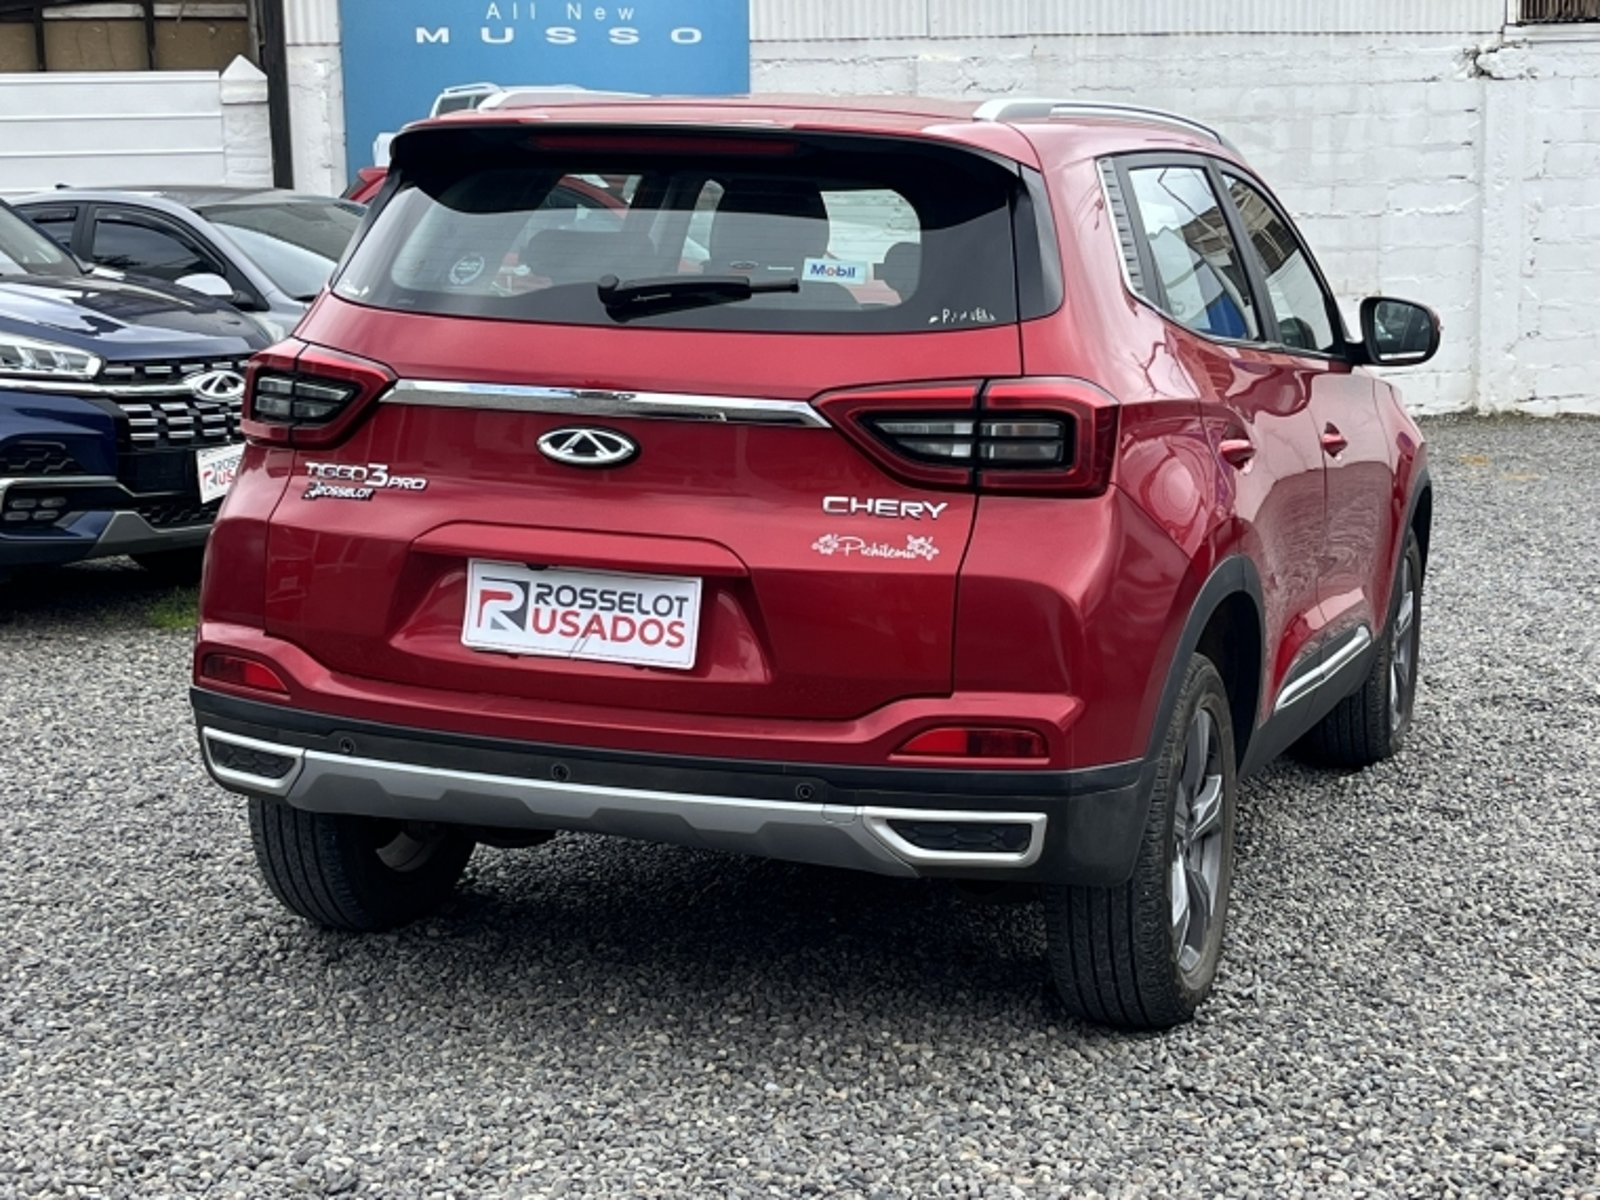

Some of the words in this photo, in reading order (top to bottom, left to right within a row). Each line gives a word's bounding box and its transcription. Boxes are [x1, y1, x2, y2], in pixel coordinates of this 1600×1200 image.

[485, 2, 536, 20] All
[566, 3, 635, 20] New
[415, 27, 702, 45] MUSSO
[810, 263, 856, 279] Mobil
[363, 462, 388, 487] 3
[387, 475, 428, 490] PRO
[822, 495, 949, 519] CHERY
[534, 582, 690, 619] ROSSELOT
[530, 607, 686, 649] USADOS
